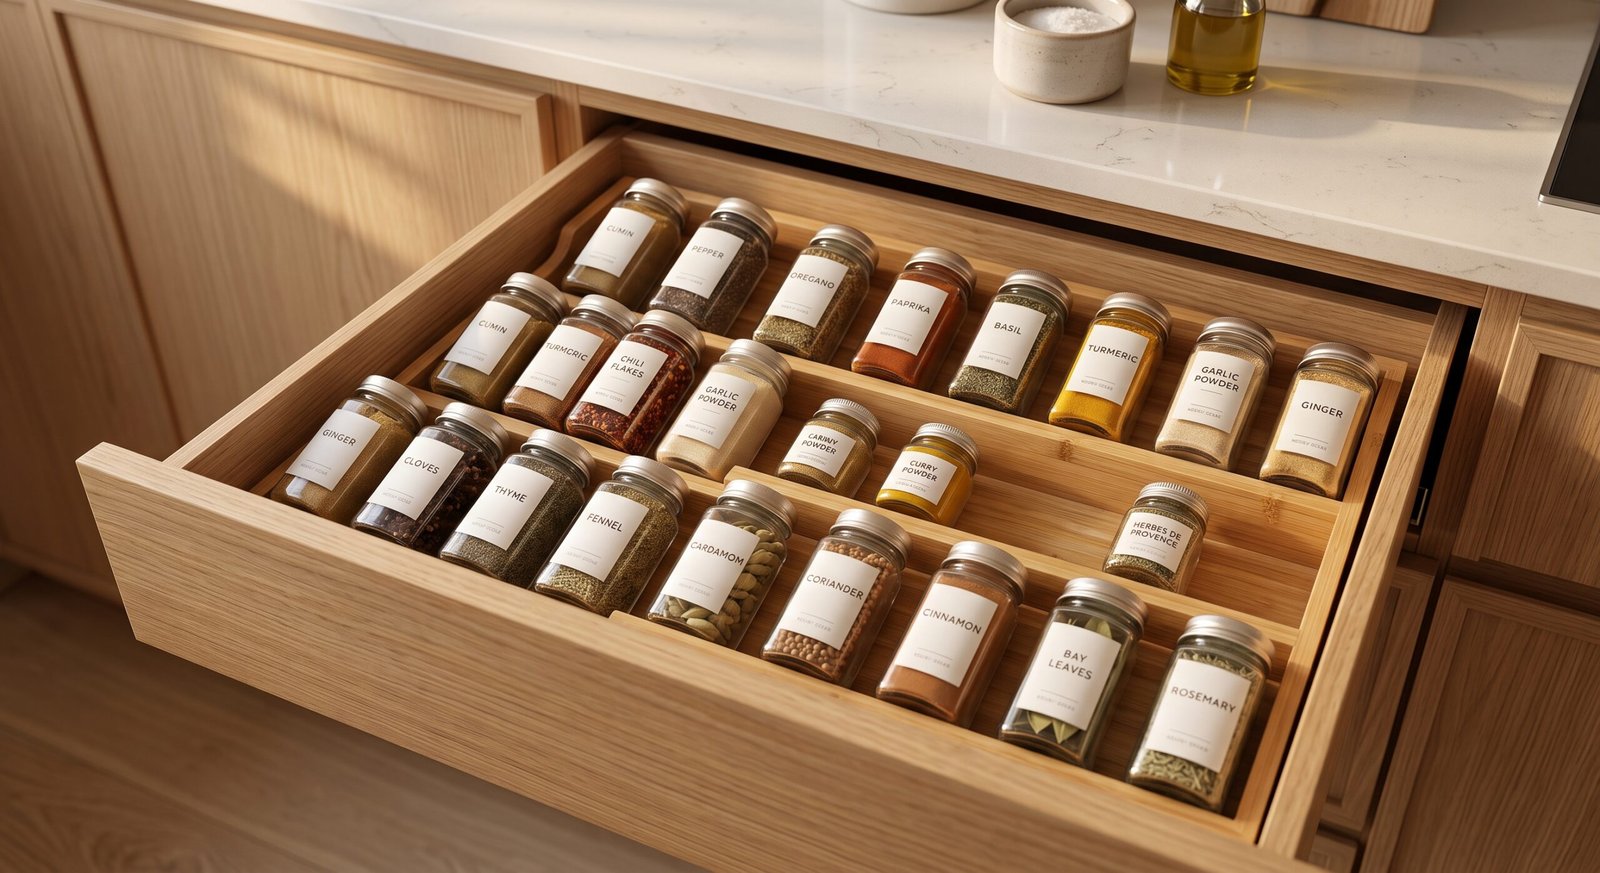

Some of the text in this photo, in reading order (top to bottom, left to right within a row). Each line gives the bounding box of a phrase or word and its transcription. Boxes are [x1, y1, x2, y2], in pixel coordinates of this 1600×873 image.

[606, 225, 635, 237] CUMIN
[692, 245, 724, 259] PEPPER
[790, 272, 835, 289] OREGANO
[891, 298, 930, 314] PAPRIKA
[478, 320, 508, 334] CUMIN
[994, 322, 1022, 335] BASIL
[620, 355, 645, 367] CHILI
[1088, 344, 1138, 363] TURMERIC
[611, 362, 645, 378] FLAKES
[1201, 366, 1240, 381] GARLIC
[1194, 375, 1240, 392] POWDER
[705, 386, 739, 401] GARLIC
[697, 394, 737, 411] POWDER
[1301, 401, 1344, 418] GINGER
[322, 429, 356, 447] GINGER
[802, 440, 837, 455] POWDER
[404, 456, 440, 475] CLOVES
[902, 466, 938, 482] POWDER
[909, 460, 938, 472] CURRY
[494, 485, 528, 503] THYME
[587, 512, 622, 532] FENNEL
[1130, 529, 1179, 549] PROVENCE
[1133, 522, 1182, 540] HERBES DE
[690, 541, 745, 566] CARDAMOM
[806, 574, 864, 600] CORIANDER
[922, 608, 982, 634] CINNAMON
[1063, 649, 1088, 662] BAY
[1048, 659, 1092, 680] LEAVES
[1171, 686, 1236, 713] ROSEMARY
